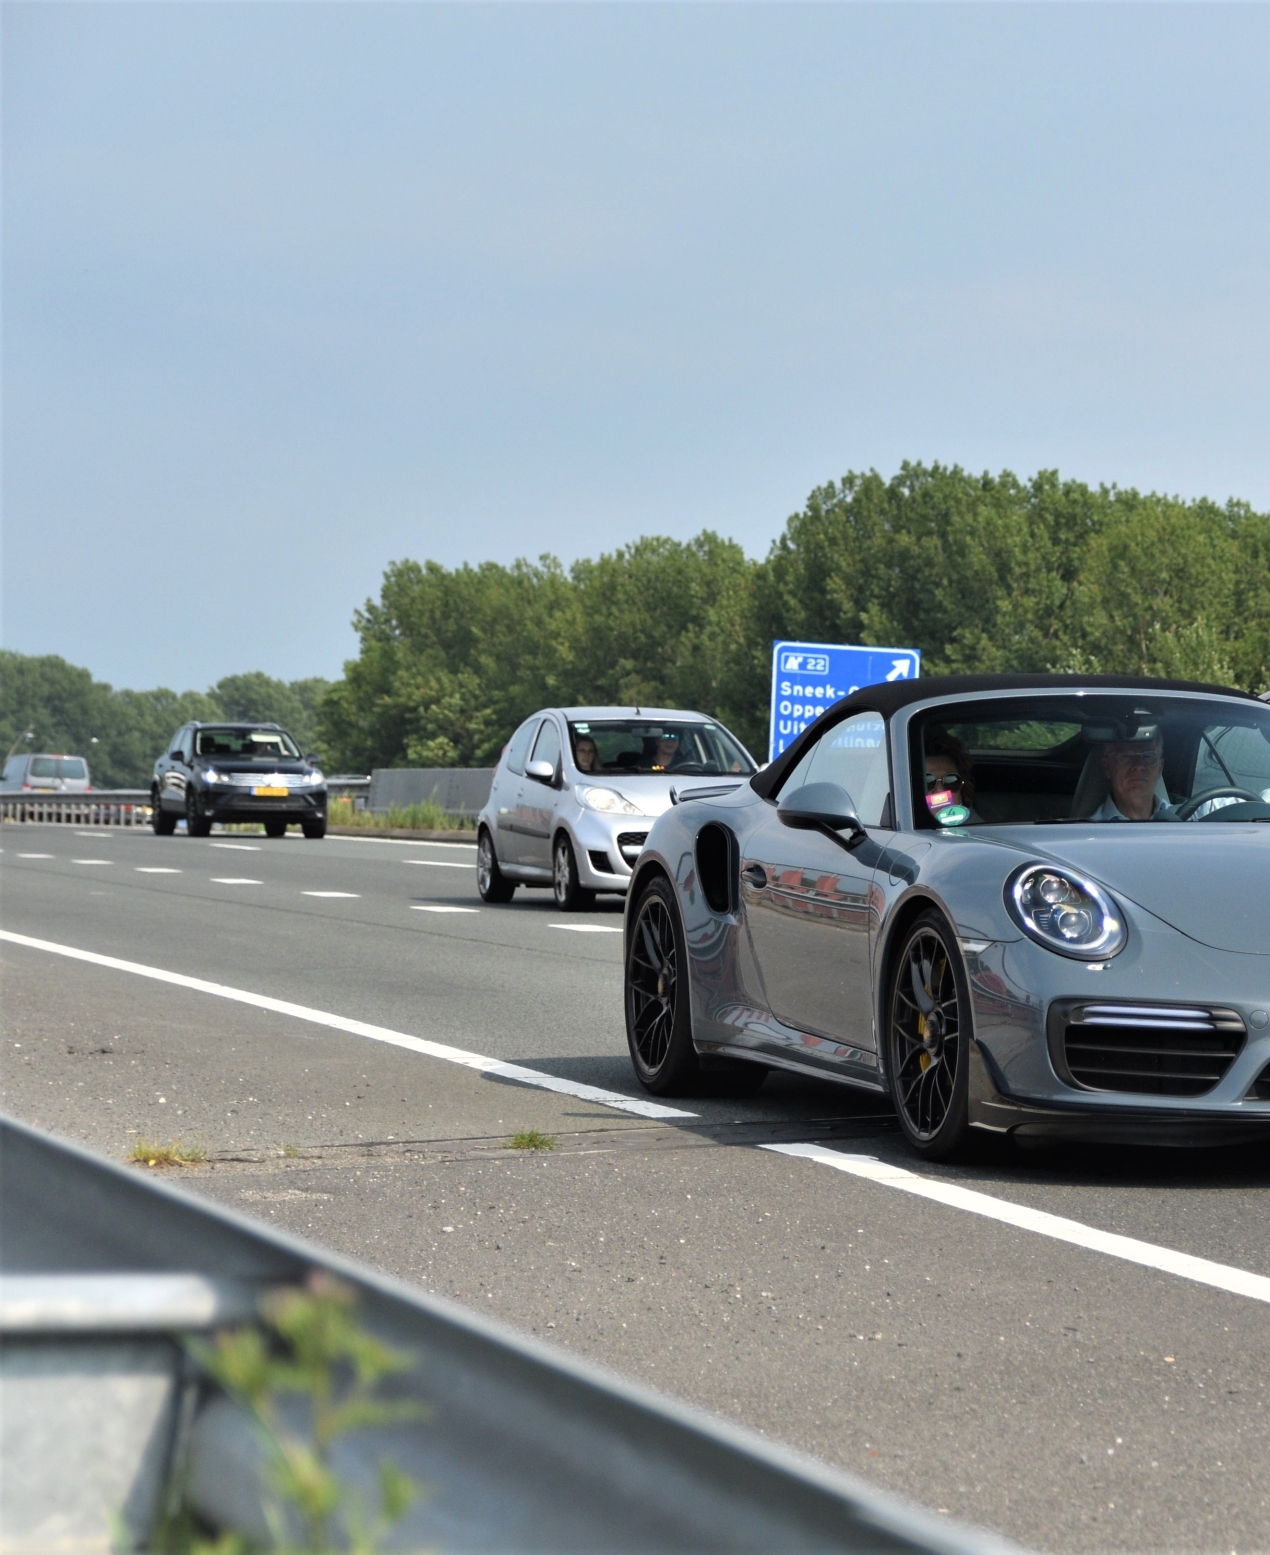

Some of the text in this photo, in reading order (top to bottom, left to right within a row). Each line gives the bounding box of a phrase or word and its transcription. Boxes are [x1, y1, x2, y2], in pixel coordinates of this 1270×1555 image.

[806, 658, 825, 670] 22
[779, 701, 829, 718] Oppe
[778, 720, 808, 735] Uit
